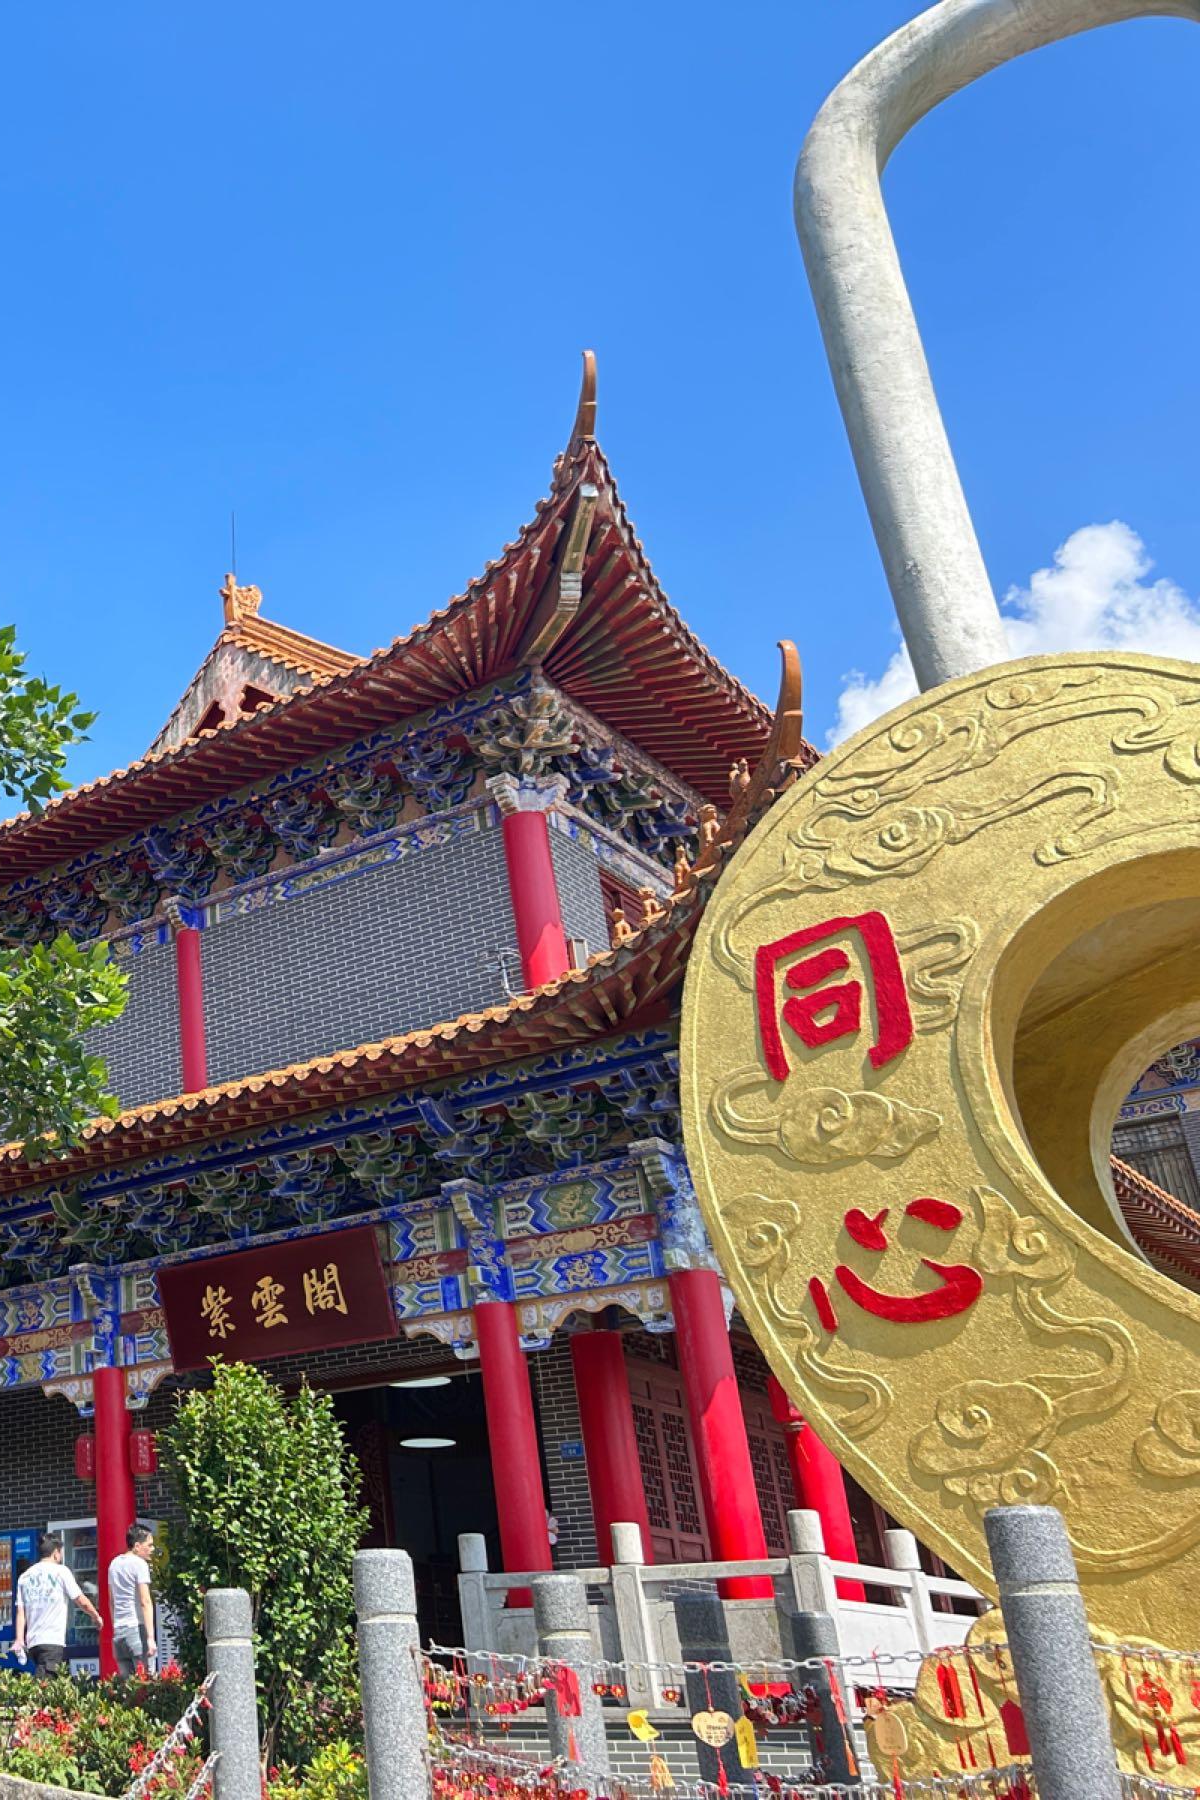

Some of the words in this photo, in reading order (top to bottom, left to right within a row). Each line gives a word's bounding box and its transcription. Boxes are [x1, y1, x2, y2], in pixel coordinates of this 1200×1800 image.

[755, 910, 985, 1334] 同心
[200, 1262, 348, 1339] 紫雲閣
